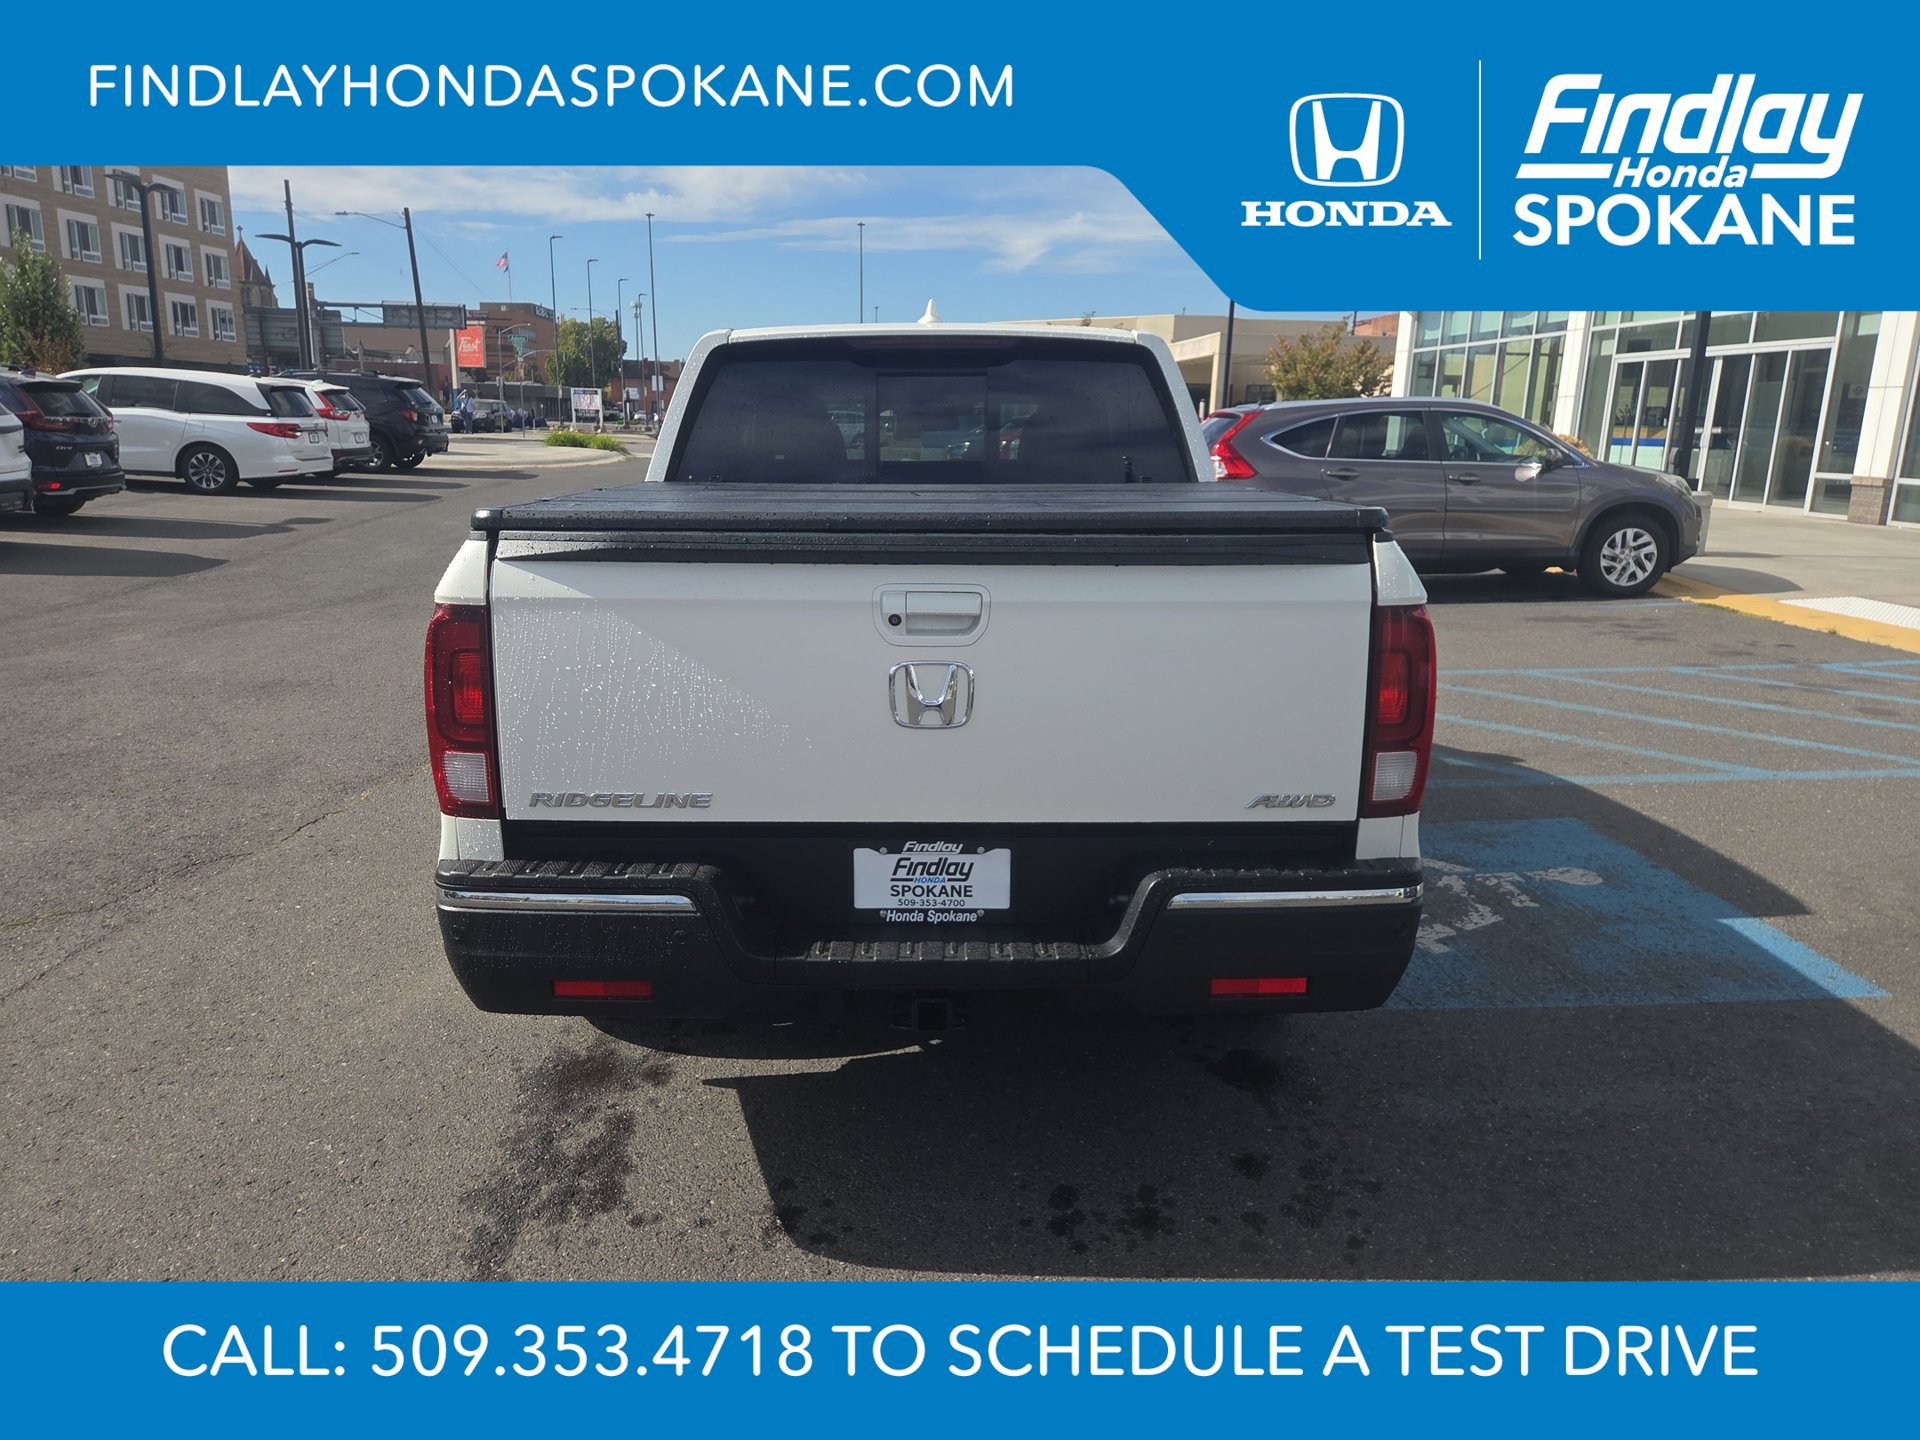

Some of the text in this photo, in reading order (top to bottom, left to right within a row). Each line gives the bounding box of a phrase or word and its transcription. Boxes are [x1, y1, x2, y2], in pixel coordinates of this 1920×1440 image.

[528, 791, 713, 809] RIDGELINE
[1245, 793, 1336, 809] AWD
[901, 841, 964, 855] Findlay
[890, 857, 975, 882] Findlay
[890, 885, 974, 898] SPOKANE
[897, 899, 966, 907] 509-353-4700
[886, 909, 978, 924] Honda Spokane
